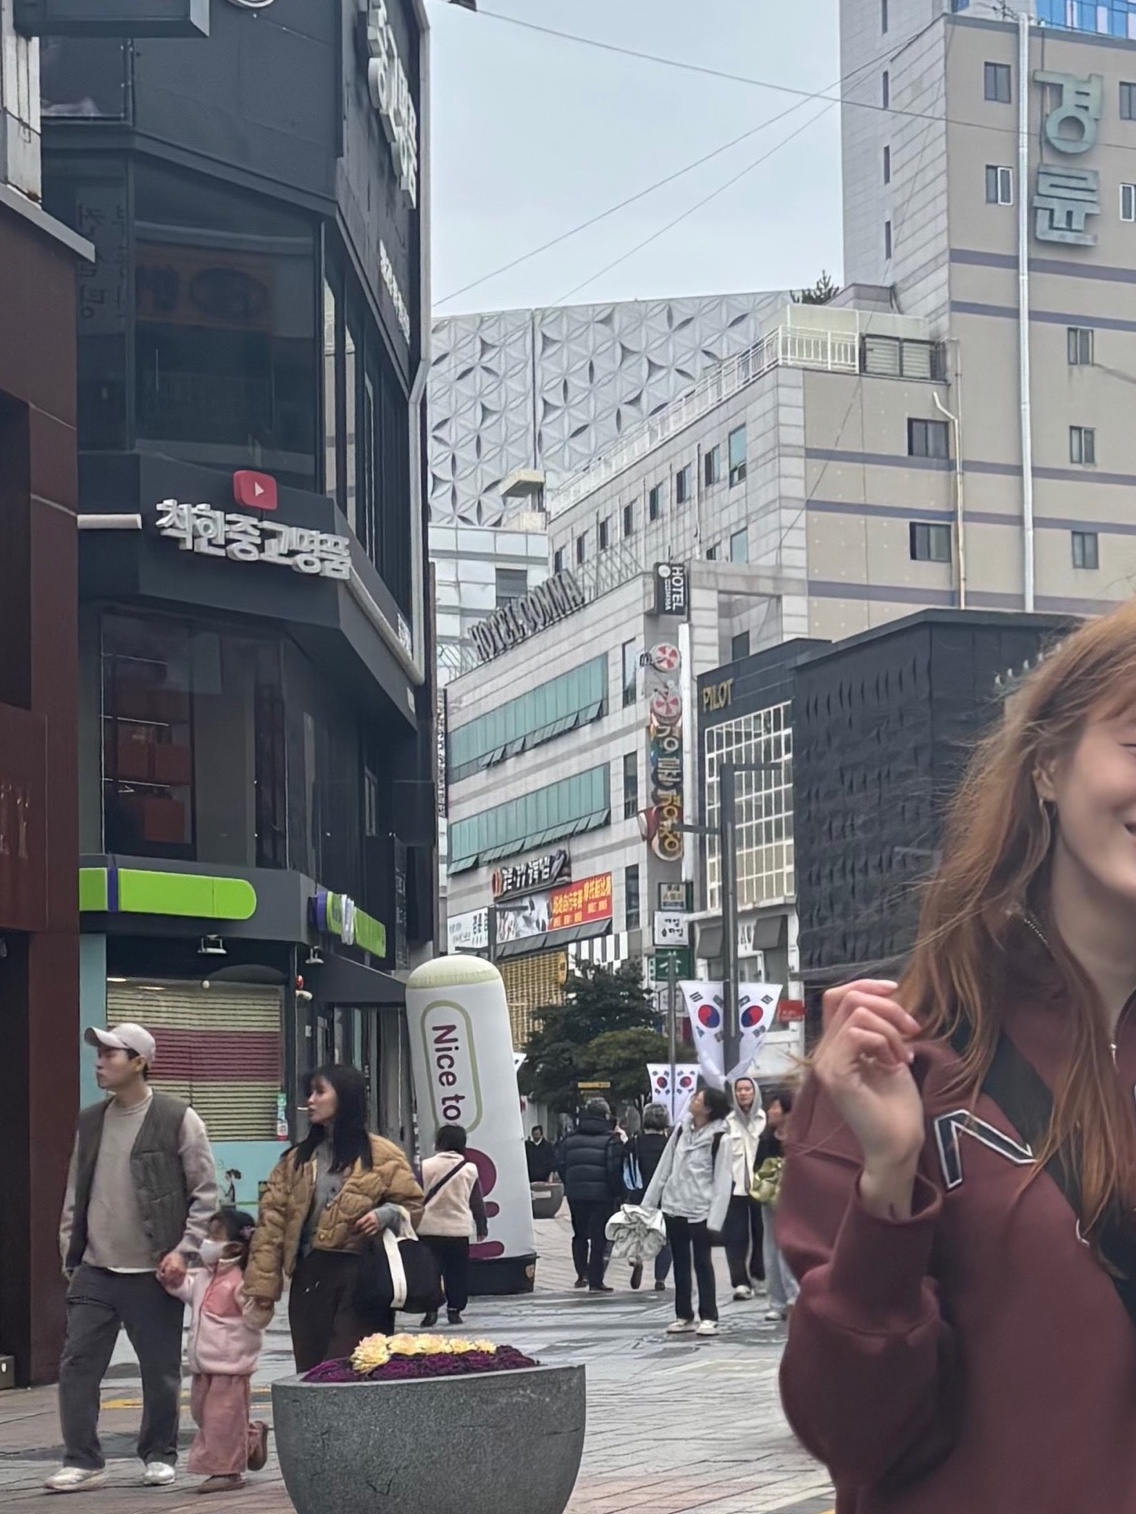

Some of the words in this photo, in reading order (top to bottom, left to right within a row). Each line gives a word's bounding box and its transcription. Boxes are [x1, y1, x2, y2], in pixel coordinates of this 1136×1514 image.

[155, 499, 351, 580] 착한중고명품
[468, 603, 526, 662] HOTEL
[515, 568, 586, 632] COMMA
[671, 566, 684, 611] HOTEL
[703, 678, 733, 712] PILOT
[431, 1024, 459, 1087] Nice
[441, 1094, 466, 1121] to
